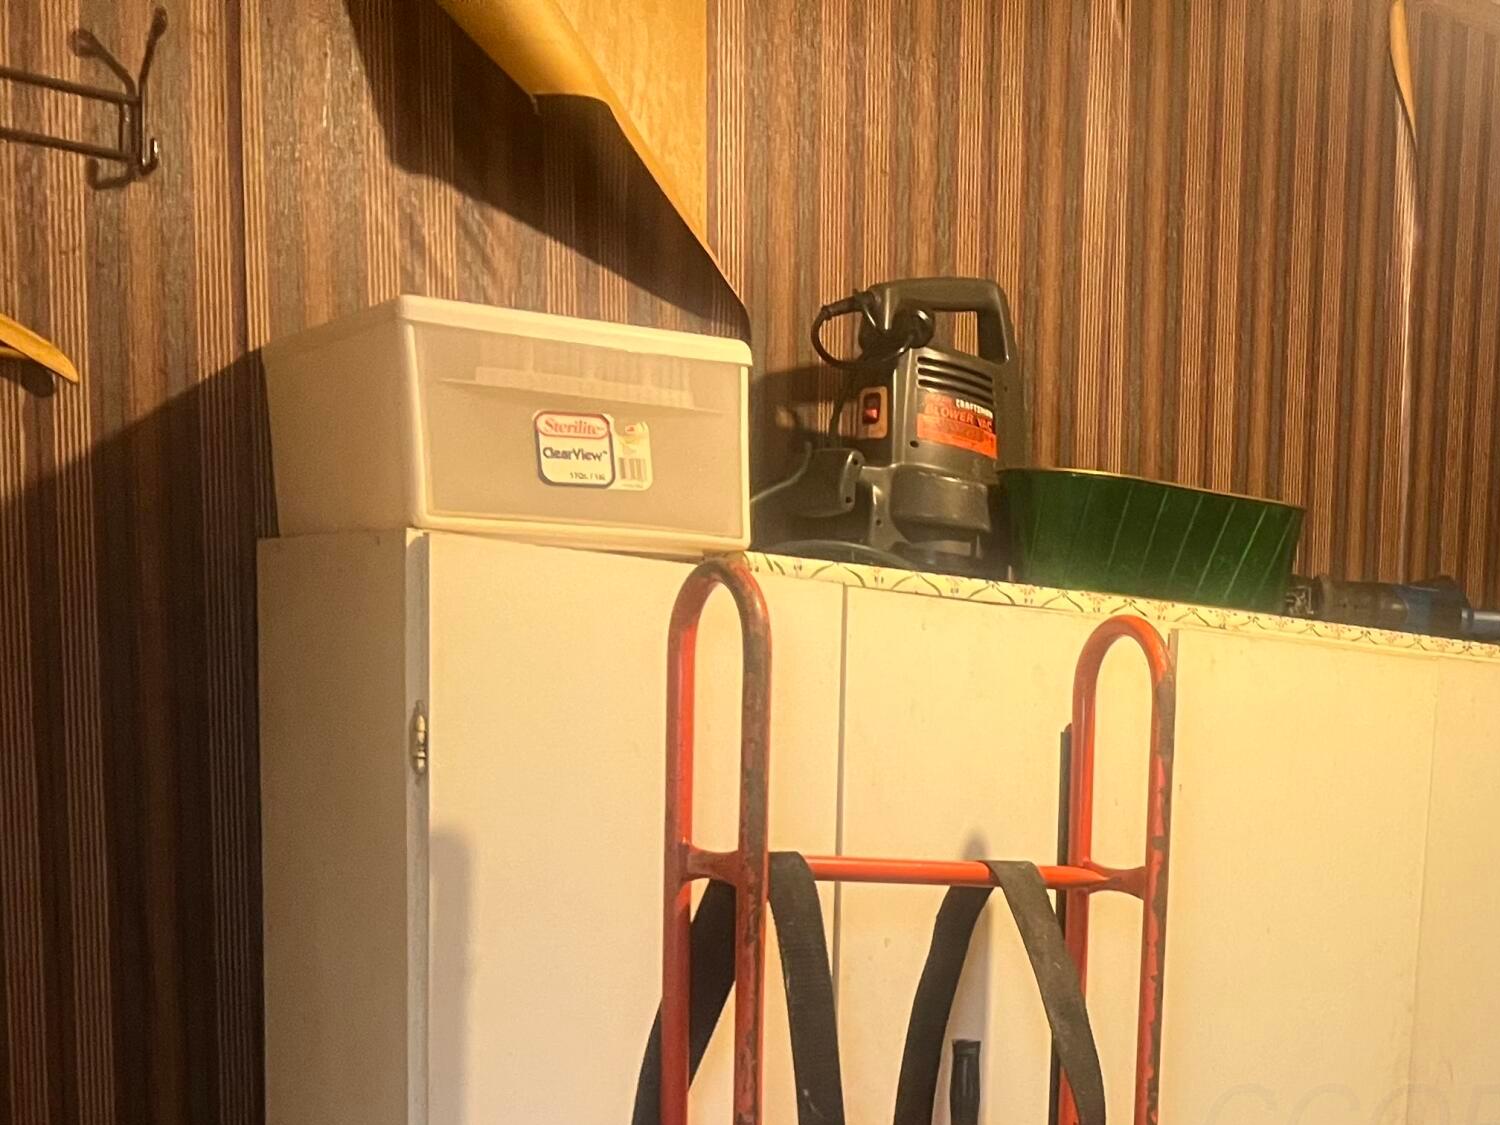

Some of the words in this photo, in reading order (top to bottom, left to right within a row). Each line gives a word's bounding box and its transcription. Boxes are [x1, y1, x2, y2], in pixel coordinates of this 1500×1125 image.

[543, 417, 601, 435] Sterilite
[924, 402, 975, 425] BLOWER
[976, 417, 994, 434] VAC
[542, 446, 604, 463] ClearView
